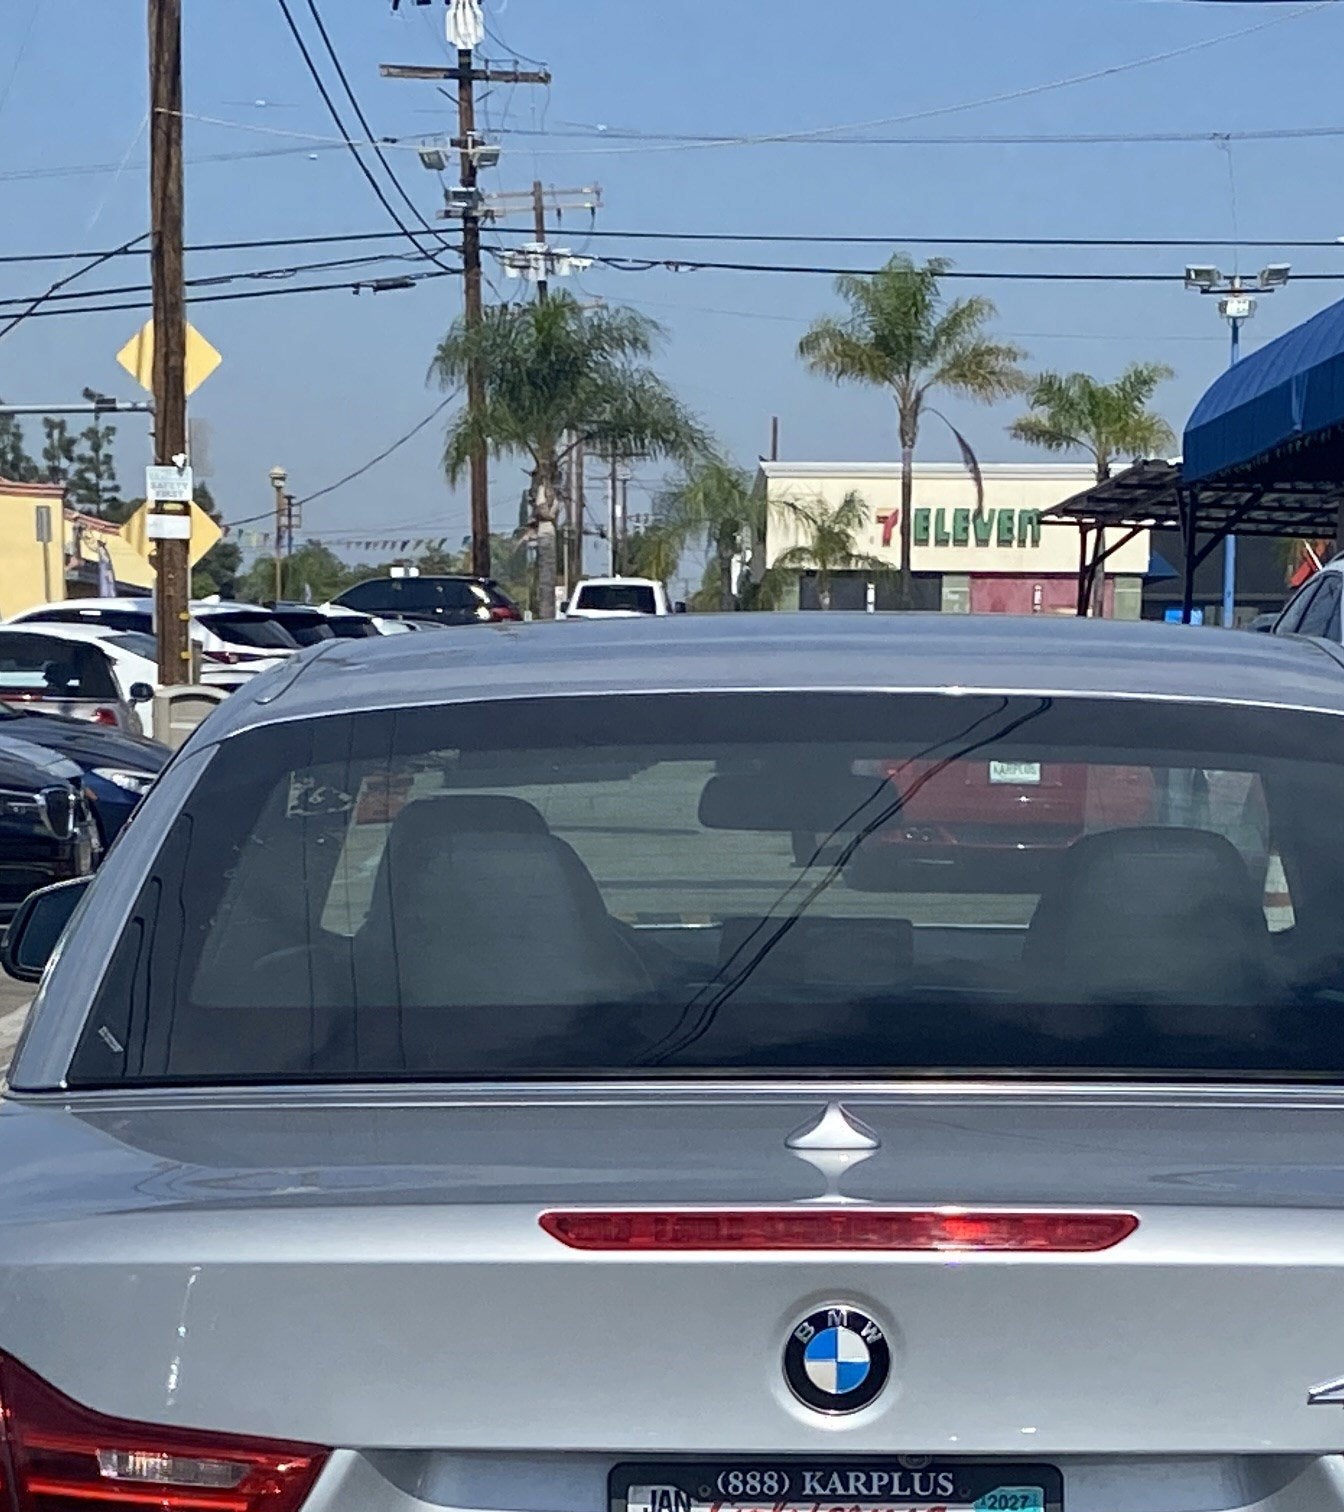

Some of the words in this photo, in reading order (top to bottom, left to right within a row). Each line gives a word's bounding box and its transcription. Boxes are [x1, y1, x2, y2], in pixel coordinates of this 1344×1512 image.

[794, 1308, 883, 1344] BMW
[717, 1470, 790, 1497] (888)
[803, 1471, 954, 1496] KARPLUS
[987, 1494, 1030, 1511] 2027
